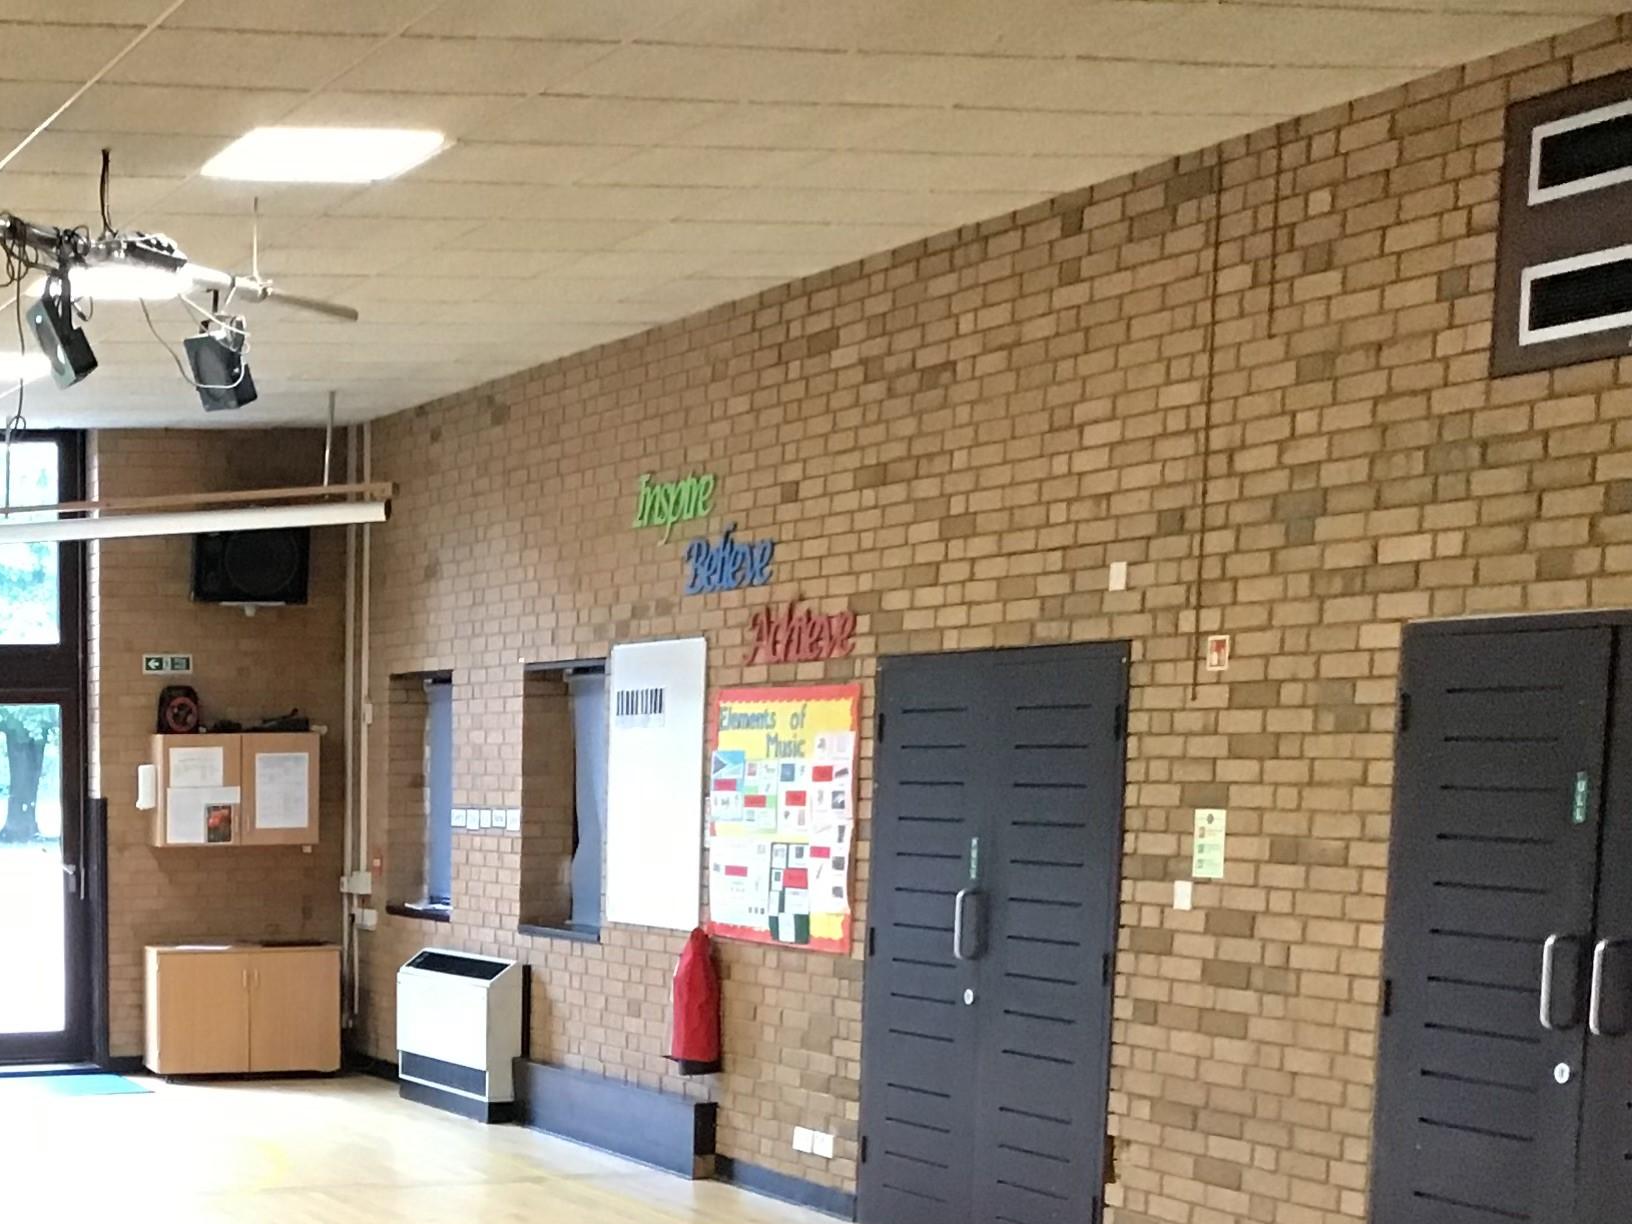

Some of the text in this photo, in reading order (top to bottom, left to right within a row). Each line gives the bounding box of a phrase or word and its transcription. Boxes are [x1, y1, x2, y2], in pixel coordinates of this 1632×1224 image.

[632, 471, 715, 546] Inspire
[683, 521, 776, 596] Believe
[742, 600, 856, 666] Achieve
[719, 703, 808, 731] Elements of
[766, 733, 805, 758] Music
